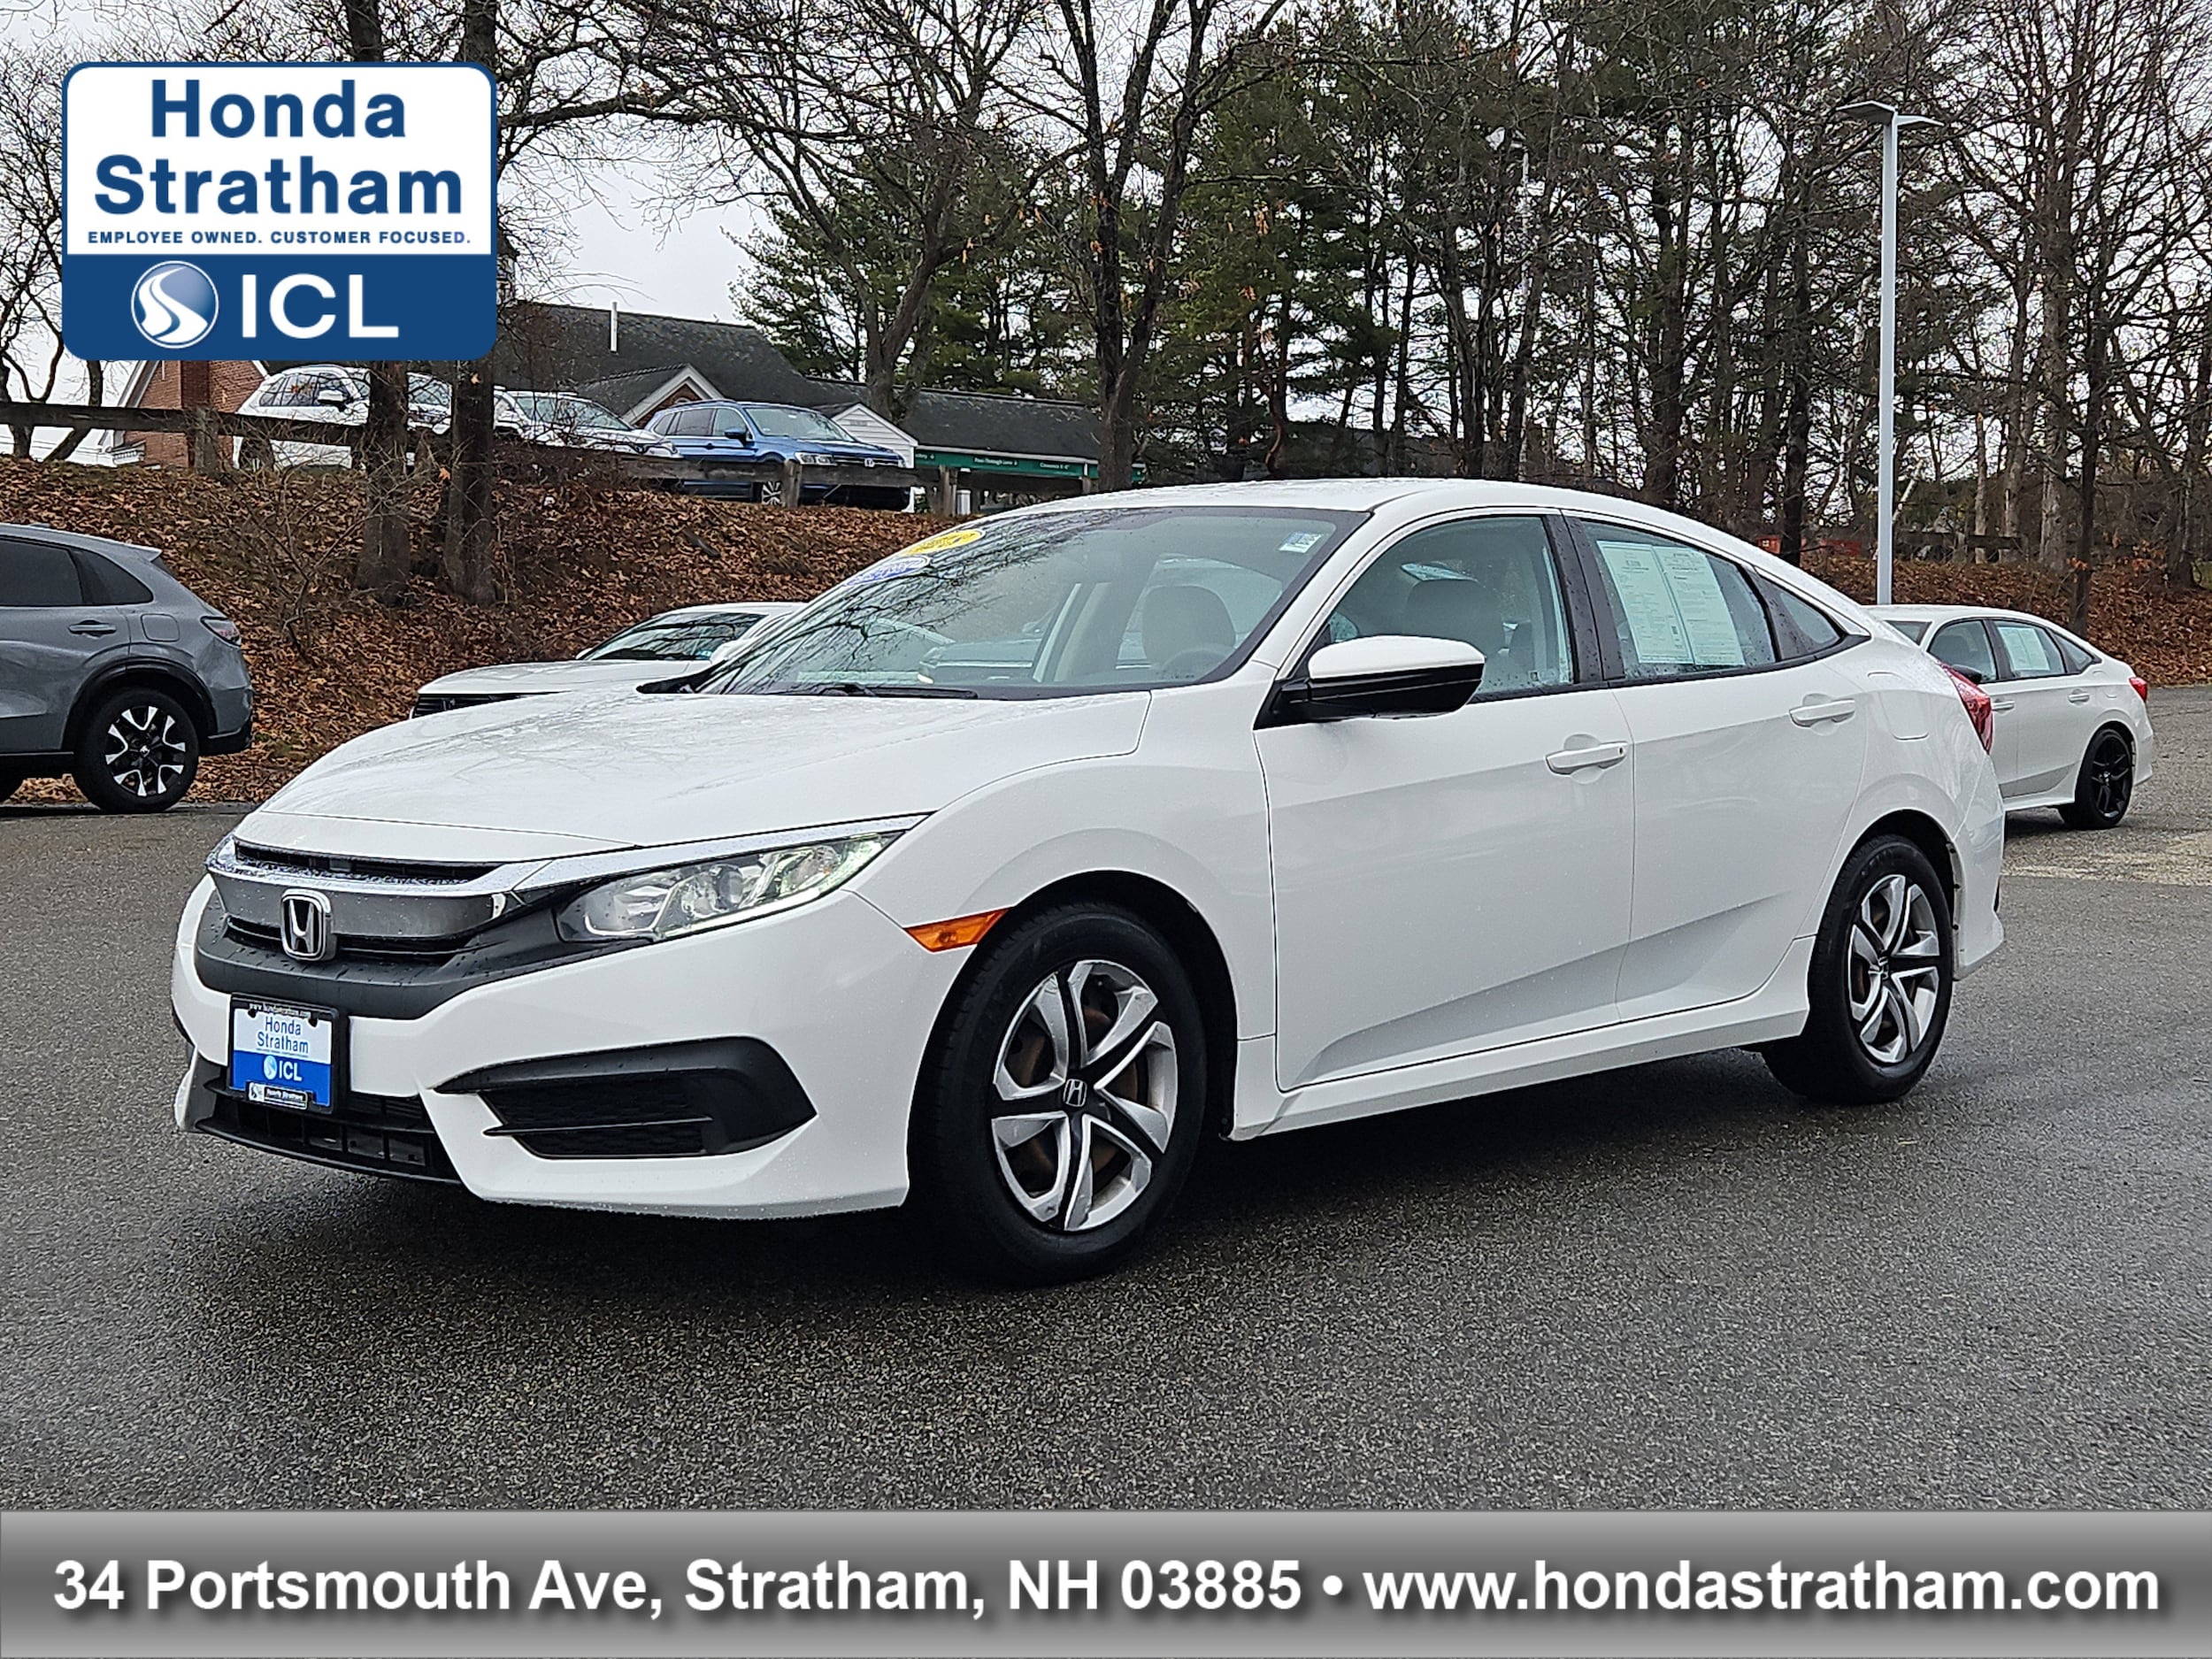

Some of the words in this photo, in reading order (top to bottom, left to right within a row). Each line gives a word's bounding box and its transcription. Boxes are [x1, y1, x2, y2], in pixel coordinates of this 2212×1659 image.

[265, 1016, 302, 1036] Honda
[257, 1031, 309, 1054] Stratham
[279, 1060, 303, 1081] ICL
